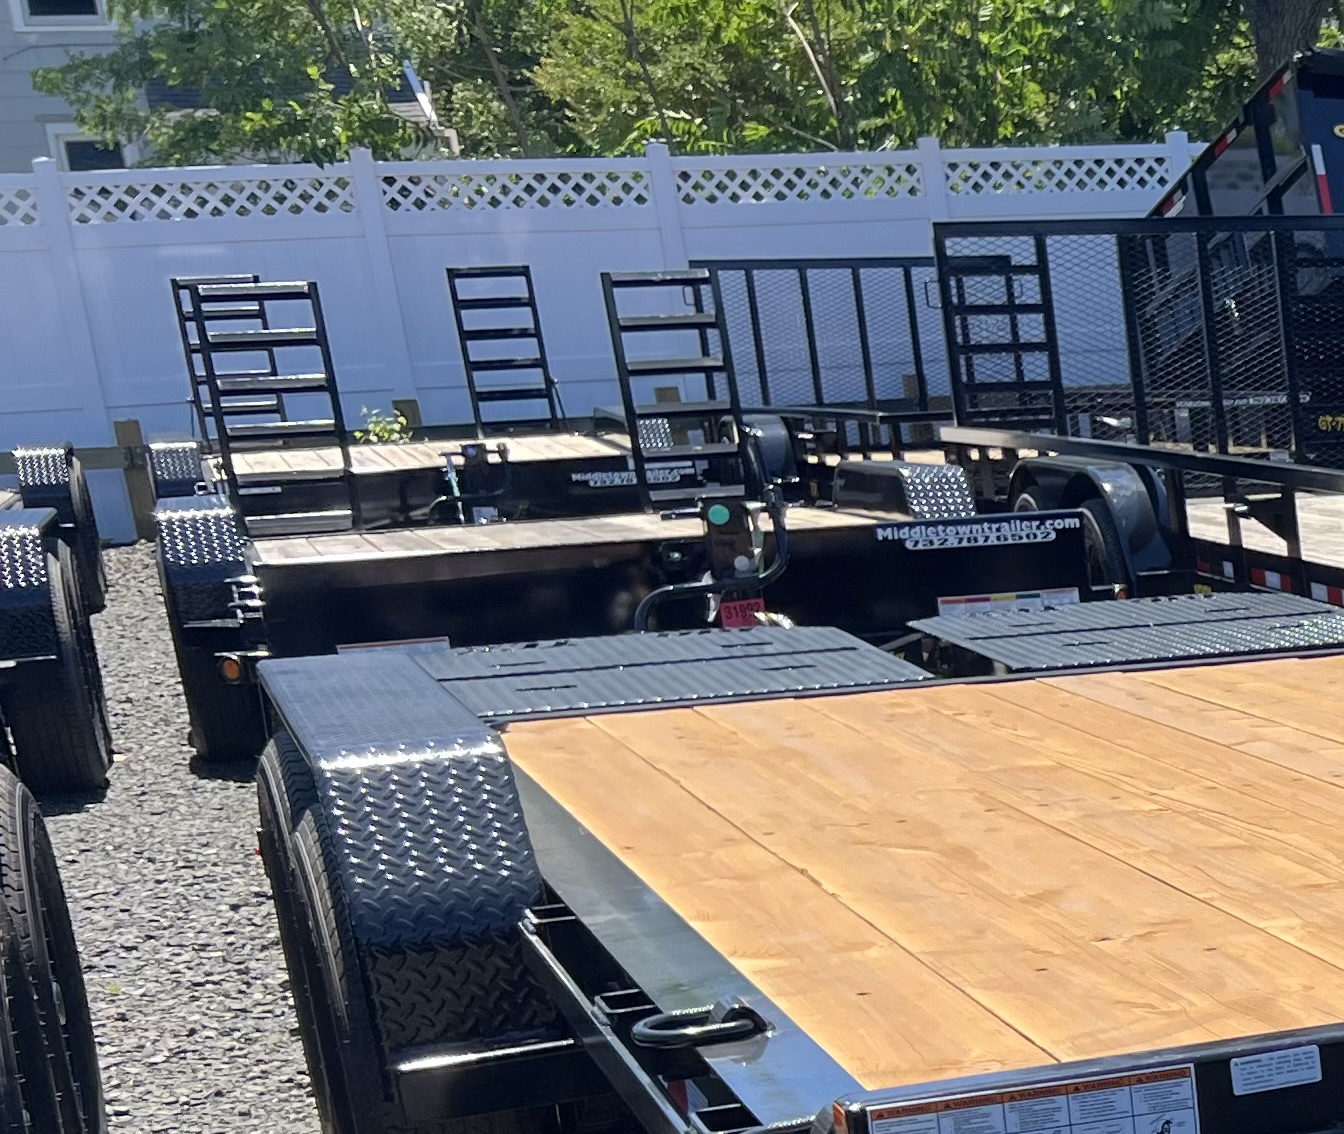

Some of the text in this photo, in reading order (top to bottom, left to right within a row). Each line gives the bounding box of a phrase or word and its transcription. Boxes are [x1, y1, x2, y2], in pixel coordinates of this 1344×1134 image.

[877, 518, 1080, 540] Middletowntrailer.com
[911, 531, 1053, 548] 732.787.6502
[1083, 1079, 1125, 1092] WARNING
